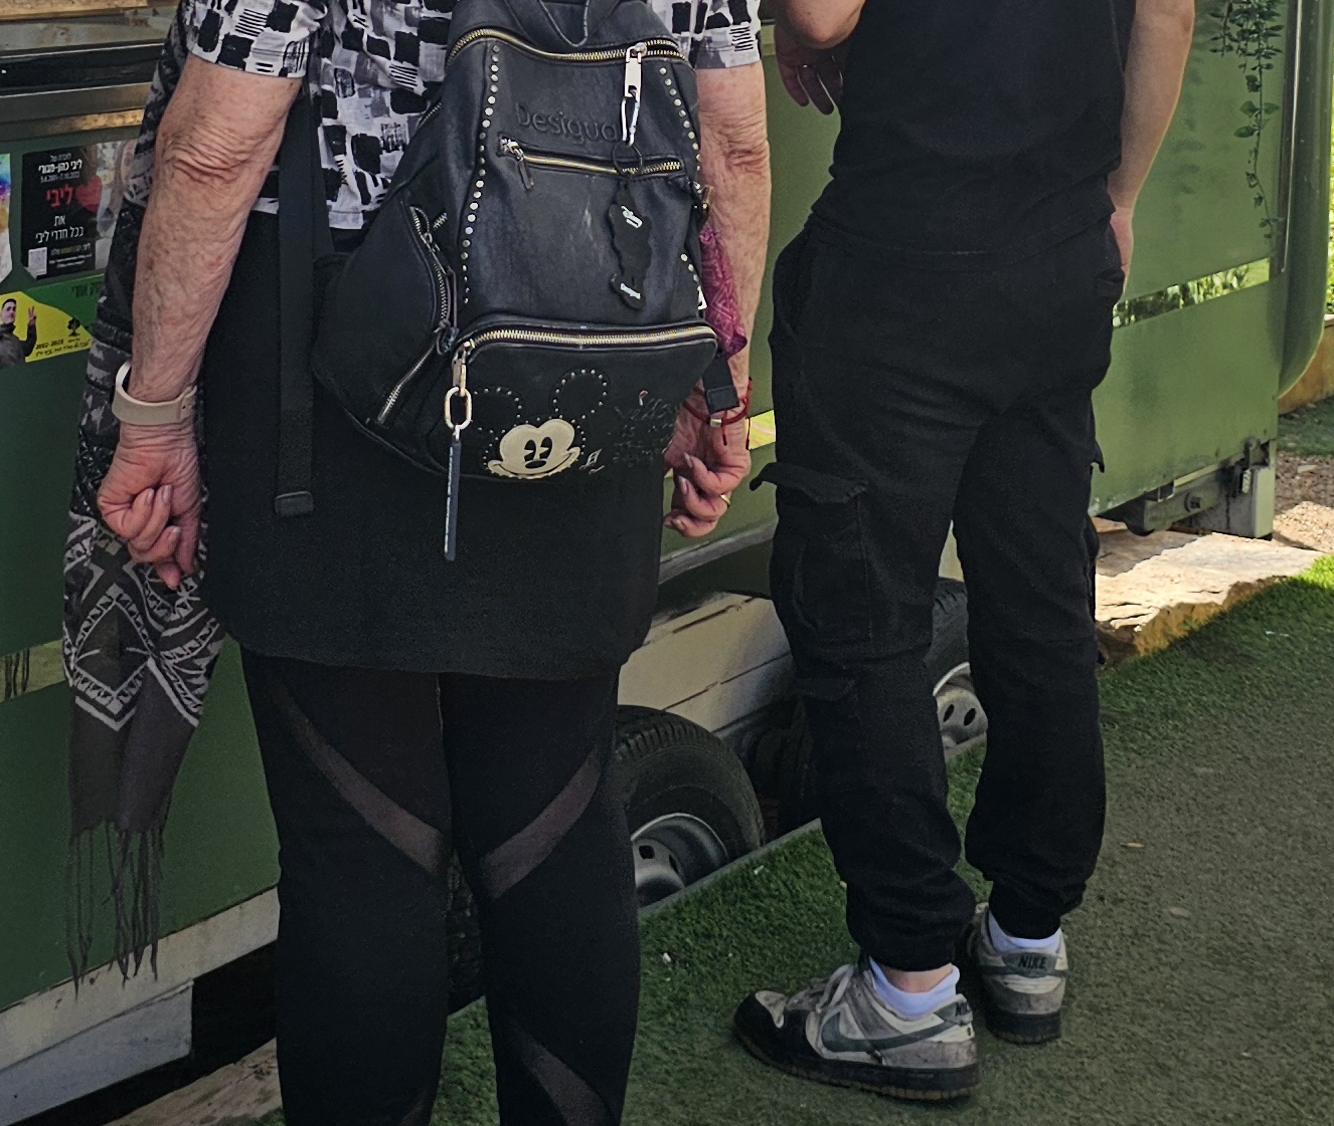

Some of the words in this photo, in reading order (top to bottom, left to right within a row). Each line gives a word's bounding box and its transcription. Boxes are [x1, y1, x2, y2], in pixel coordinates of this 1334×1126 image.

[516, 101, 618, 145] Desigua
[54, 215, 66, 227] את
[1018, 955, 1048, 970] NIKE
